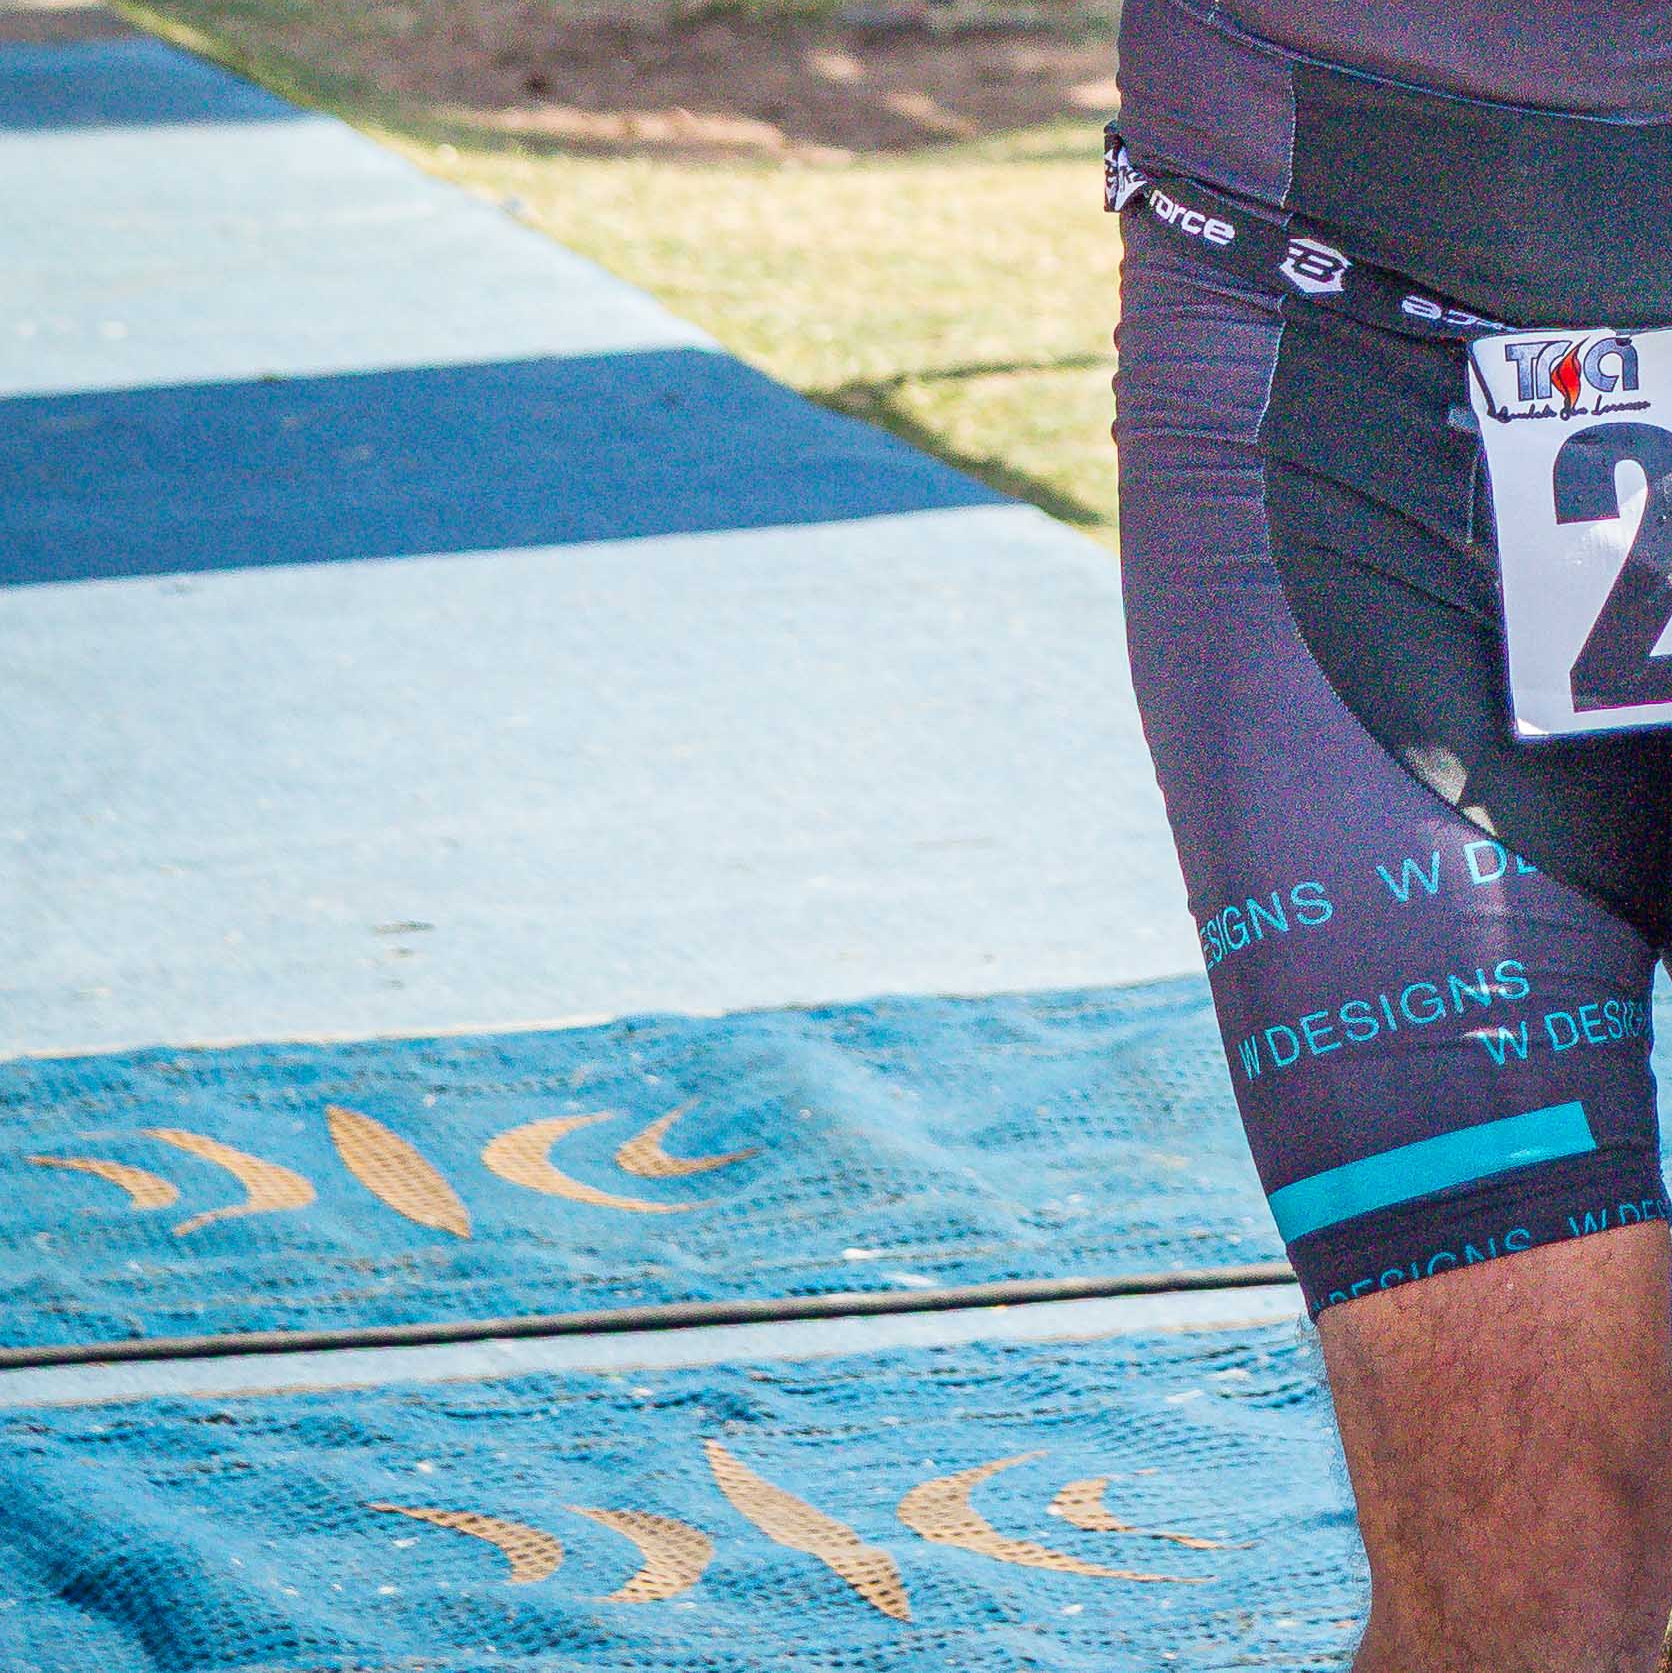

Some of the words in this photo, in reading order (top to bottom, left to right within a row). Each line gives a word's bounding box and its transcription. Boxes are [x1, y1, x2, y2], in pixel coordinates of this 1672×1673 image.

[1375, 850, 1441, 904] W
[1237, 1035, 1263, 1081] W
[1263, 958, 1531, 1068] DESIGNS
[1475, 1020, 1528, 1066] W
